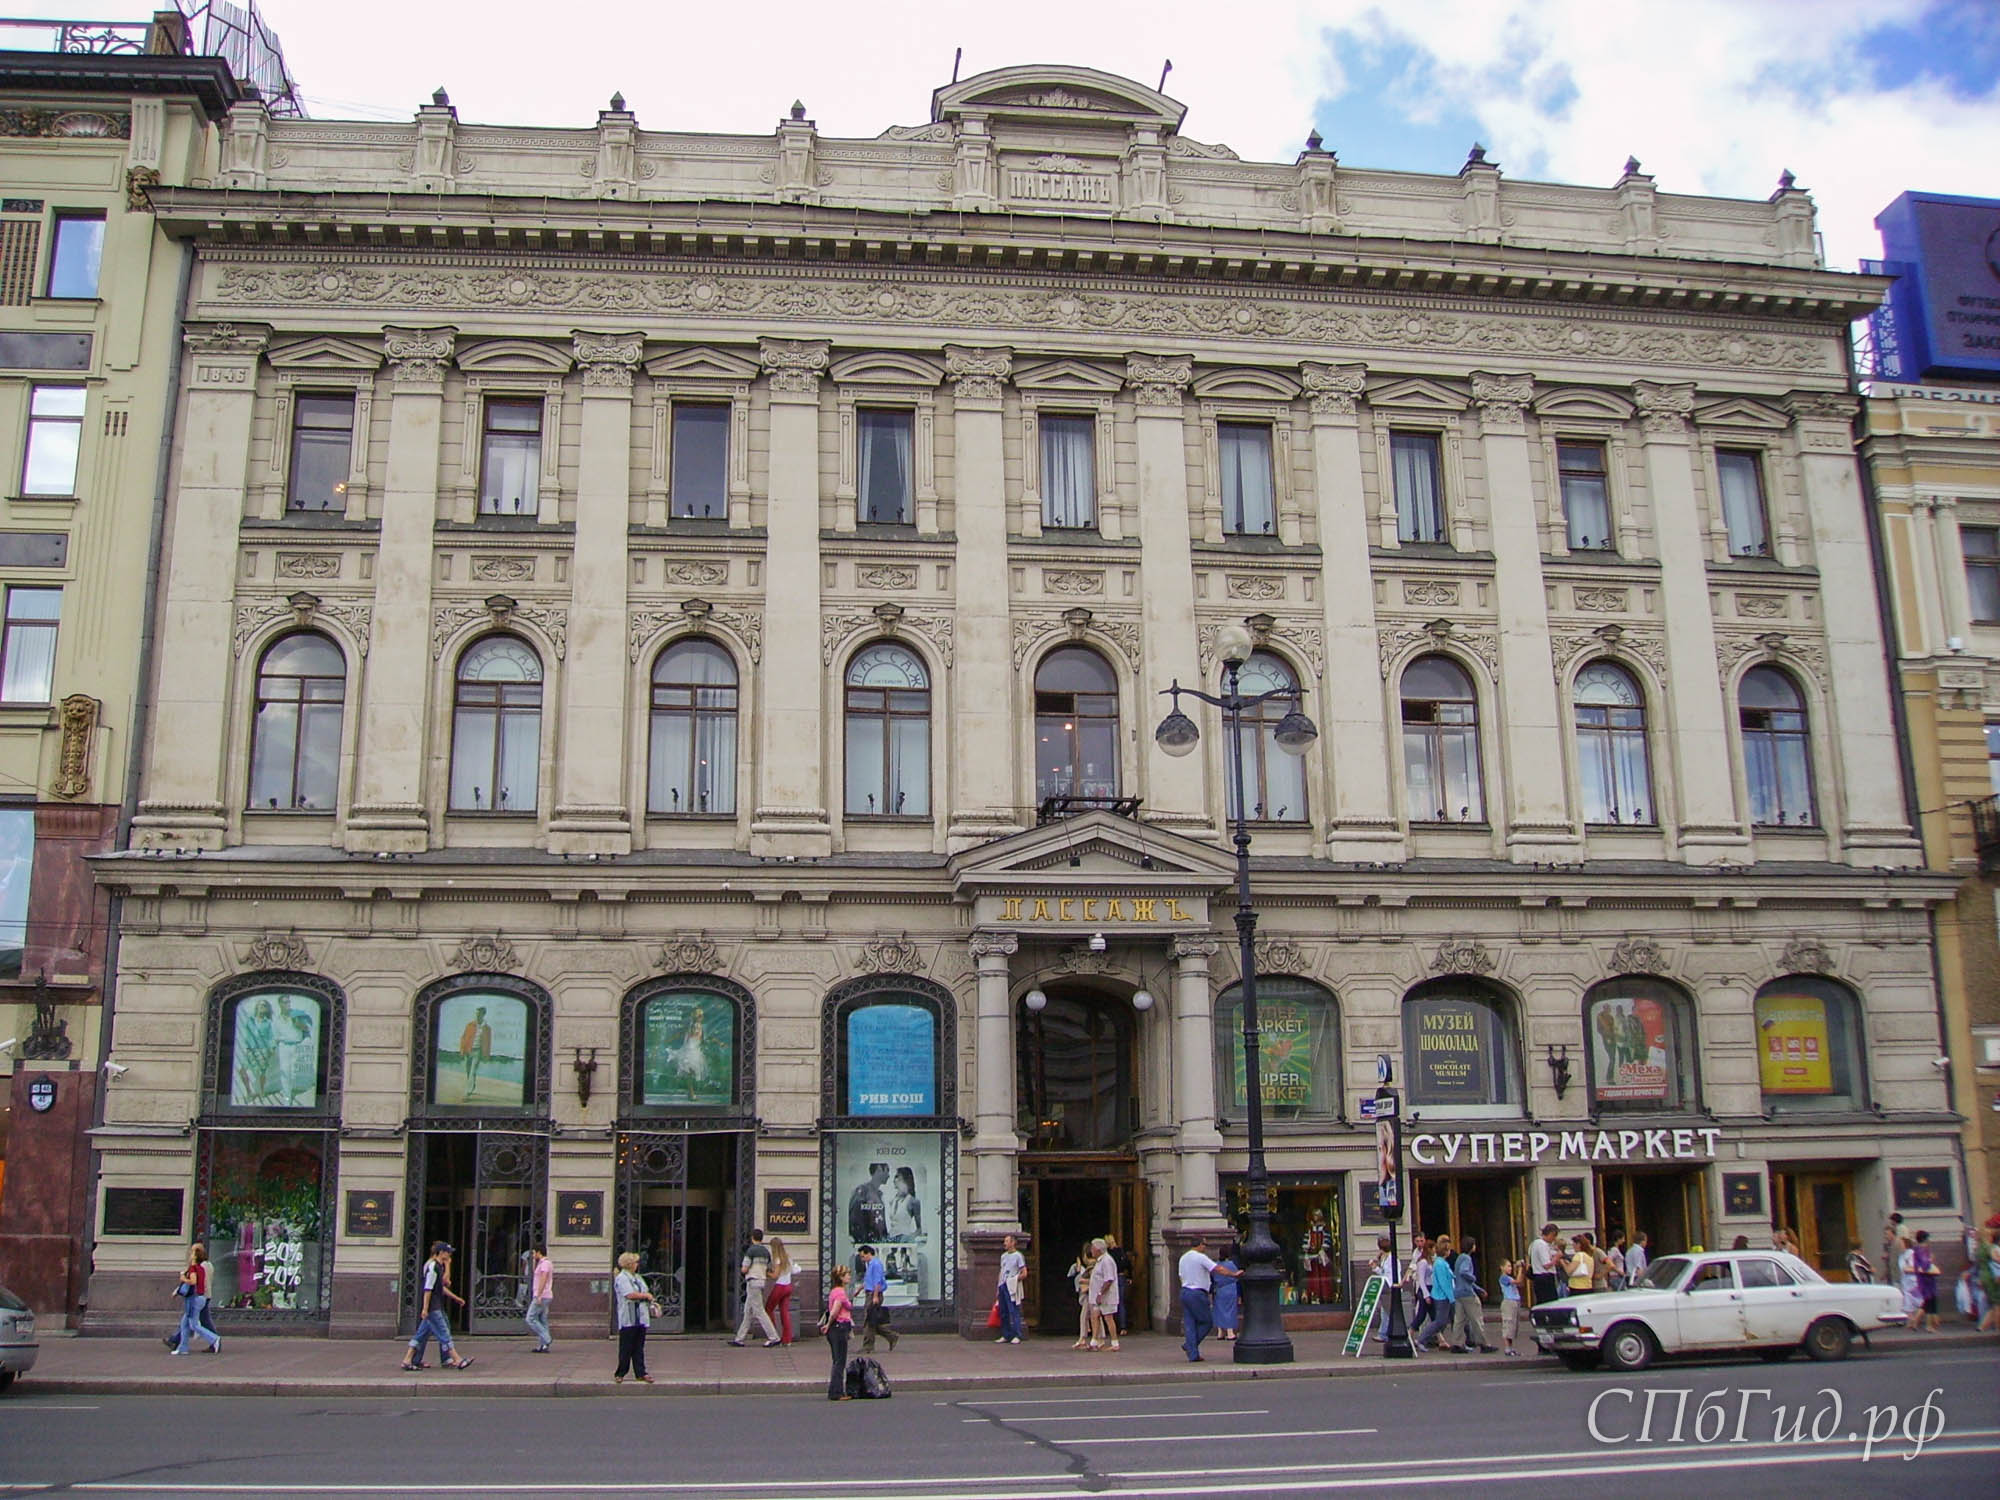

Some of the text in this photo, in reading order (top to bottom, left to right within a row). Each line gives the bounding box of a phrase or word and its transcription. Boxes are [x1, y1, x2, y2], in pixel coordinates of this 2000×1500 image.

[997, 898, 1194, 921] ПАССАЖЪ
[1423, 1011, 1475, 1031] МУЗЕЙ
[1420, 1034, 1479, 1053] ШОКОЛАДА
[1259, 1073, 1299, 1086] UPER
[859, 1092, 924, 1105] РИВ ГОШ
[1410, 1128, 1721, 1165] СУПЕРМАРКЕТ
[769, 1214, 806, 1224] ПАССАЖ
